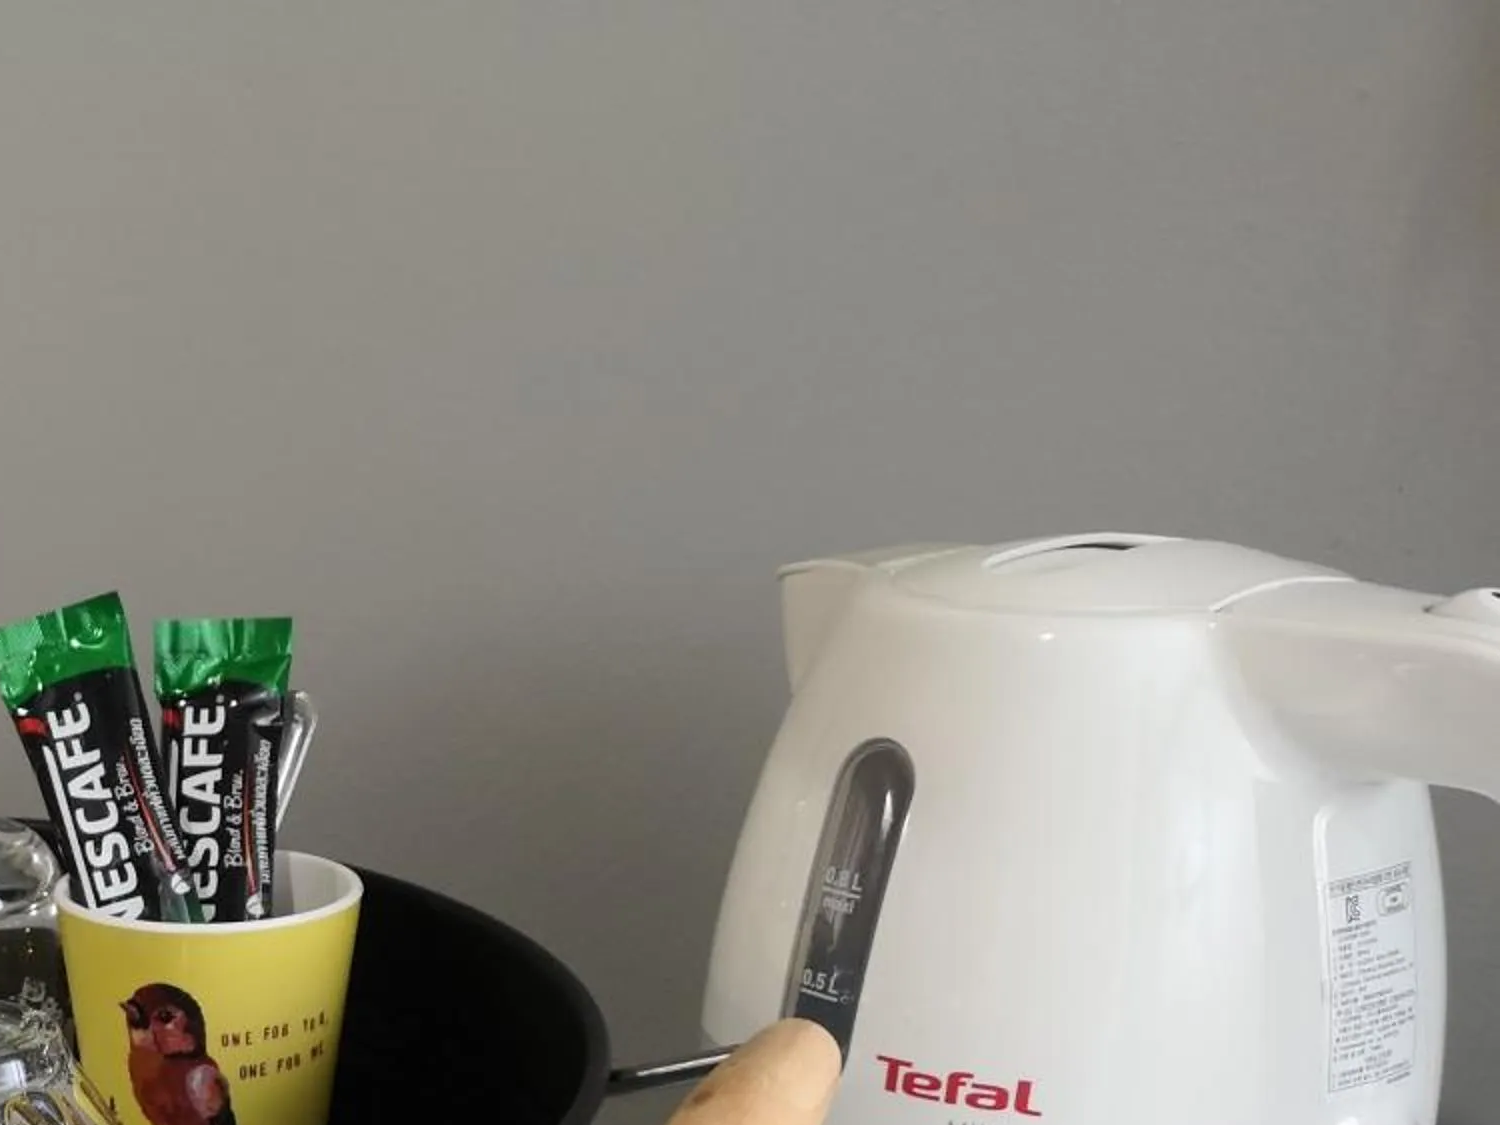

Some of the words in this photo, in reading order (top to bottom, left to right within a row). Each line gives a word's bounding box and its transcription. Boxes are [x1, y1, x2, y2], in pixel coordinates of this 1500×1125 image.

[221, 1031, 252, 1048] ONE
[239, 1062, 268, 1081] ONE
[876, 1055, 1043, 1117] Tefal
